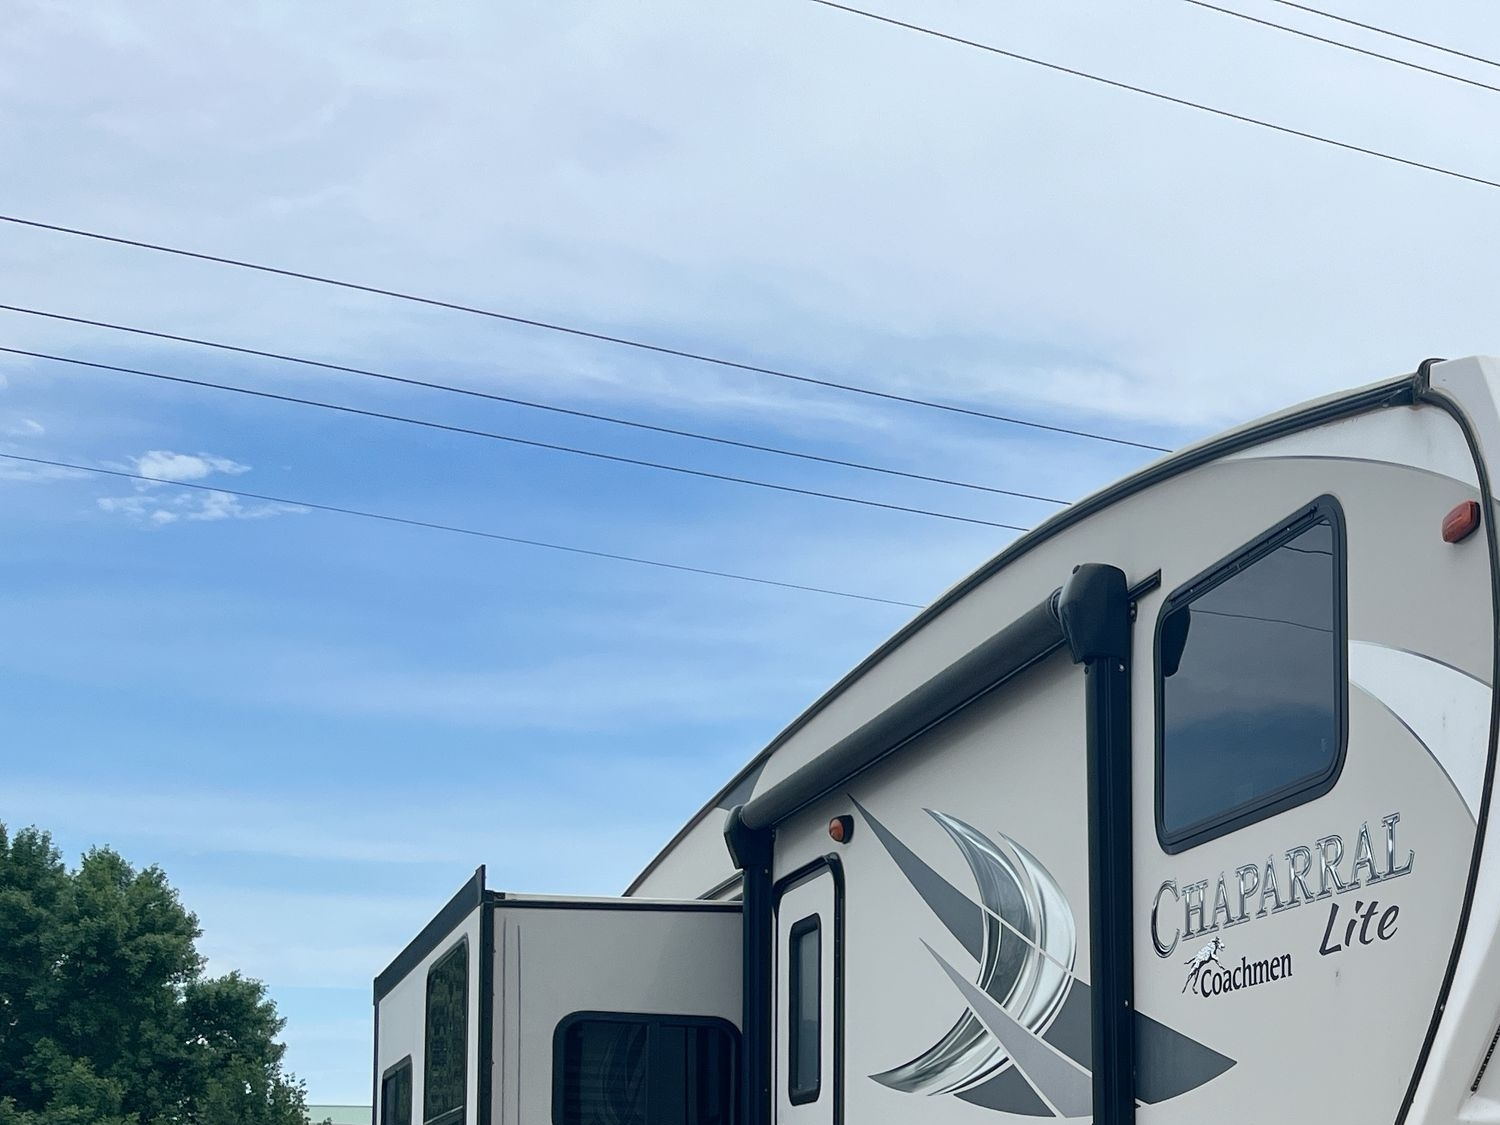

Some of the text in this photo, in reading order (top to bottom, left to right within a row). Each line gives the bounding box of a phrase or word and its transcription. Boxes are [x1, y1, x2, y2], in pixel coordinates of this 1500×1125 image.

[1150, 812, 1415, 958] CHAPARRAL
[1319, 900, 1400, 956] Lite
[1201, 953, 1293, 998] Coachmen
